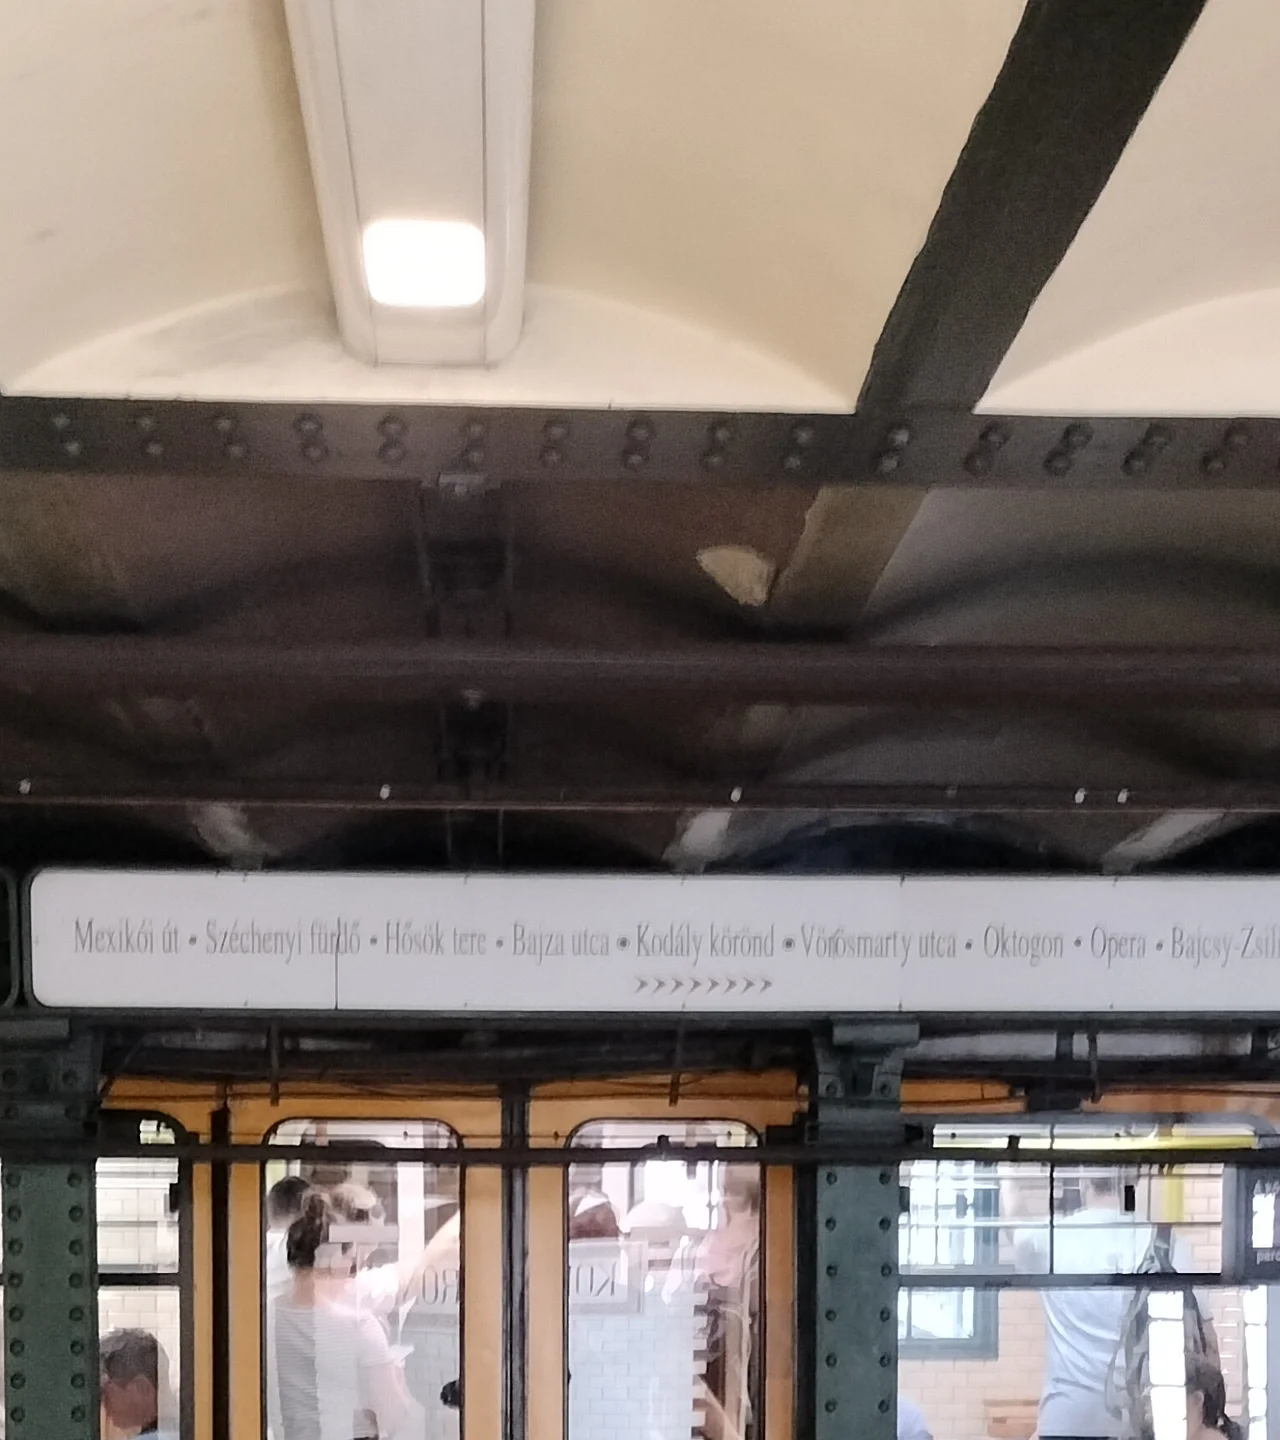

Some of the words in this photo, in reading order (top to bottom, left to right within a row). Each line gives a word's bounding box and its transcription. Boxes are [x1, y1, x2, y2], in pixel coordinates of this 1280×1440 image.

[72, 916, 153, 954] Mexikói
[162, 918, 180, 954] út
[206, 917, 302, 965] Széchenyi
[310, 917, 360, 955] fürdő
[386, 919, 444, 955] Hősök
[453, 926, 486, 955] tere
[513, 920, 565, 966] Bajza
[572, 927, 609, 956] utca
[636, 921, 703, 968] Kodály
[710, 921, 774, 957] körönd
[801, 922, 911, 968] Vörösmarty
[919, 929, 956, 958] utca
[984, 922, 1063, 967] Oktogon
[1091, 923, 1146, 969] Opera
